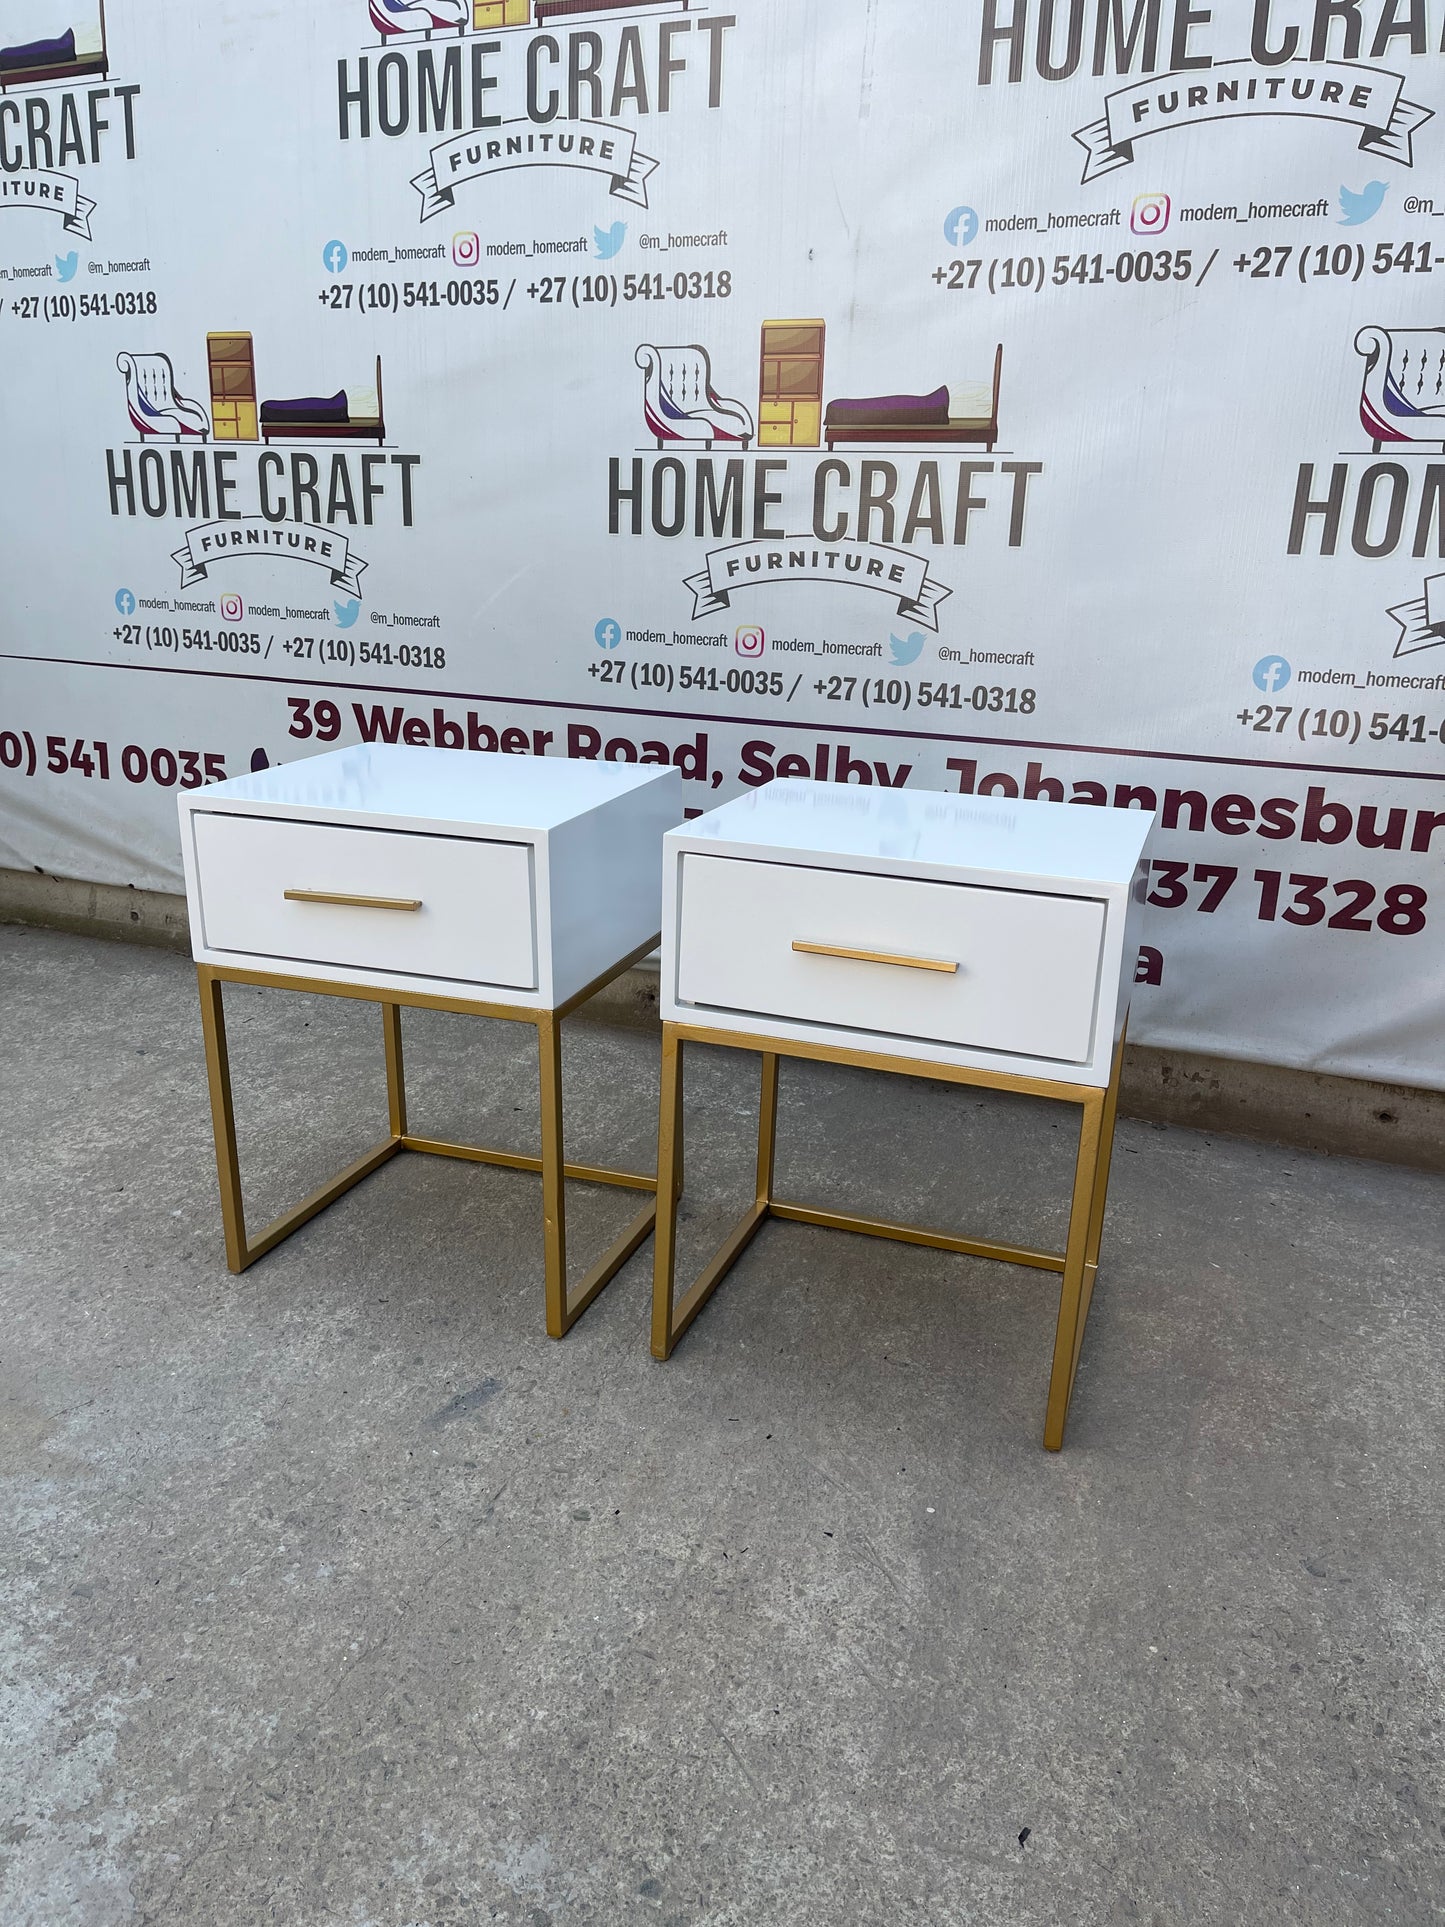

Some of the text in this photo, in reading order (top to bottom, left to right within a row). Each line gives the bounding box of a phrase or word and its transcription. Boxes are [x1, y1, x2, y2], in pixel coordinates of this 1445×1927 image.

[335, 13, 738, 141] HOME CRAFT
[1131, 76, 1374, 124] FURNITURE
[448, 132, 616, 174] FURNITURE
[639, 229, 728, 252] @m_homecraft
[87, 257, 151, 276] @m_homecraft
[931, 259, 983, 290] +27
[988, 256, 1045, 295] (10)
[1051, 249, 1193, 286] 541-0035
[1232, 246, 1293, 278] +27
[1298, 243, 1365, 284] (10)
[11, 296, 40, 319] +27
[43, 294, 77, 323] (10)
[79, 291, 158, 317] 541-0318
[318, 284, 354, 309] +27
[358, 282, 399, 314] (10)
[403, 279, 500, 308] 541-0035
[526, 276, 567, 304] +27
[571, 274, 618, 309] (10)
[622, 270, 732, 302] 541-0318
[105, 447, 421, 527] HOME CRAFT
[607, 455, 1044, 549] HOME CRAFT
[200, 528, 334, 558] FURNITURE
[726, 549, 906, 585] FURNITURE
[370, 611, 441, 628] @m_homecraft
[112, 624, 142, 645] +27
[145, 626, 179, 653] (10)
[182, 628, 261, 655] 541-0035
[282, 636, 315, 659] +27
[318, 638, 356, 667] (10)
[359, 641, 446, 670] 541-0318
[938, 646, 1035, 666] @m_homecraft
[587, 659, 626, 684] +27
[630, 662, 674, 693] (10)
[678, 665, 784, 696] 541-0035
[813, 675, 858, 701] +27
[862, 678, 912, 711] (10)
[916, 681, 1037, 715] 541-0318
[287, 696, 342, 742] 39
[351, 702, 554, 757] Webber
[1236, 704, 1293, 734] +27
[1298, 707, 1362, 745] (10)
[46, 735, 110, 780] 541
[1253, 868, 1429, 937] 1328
